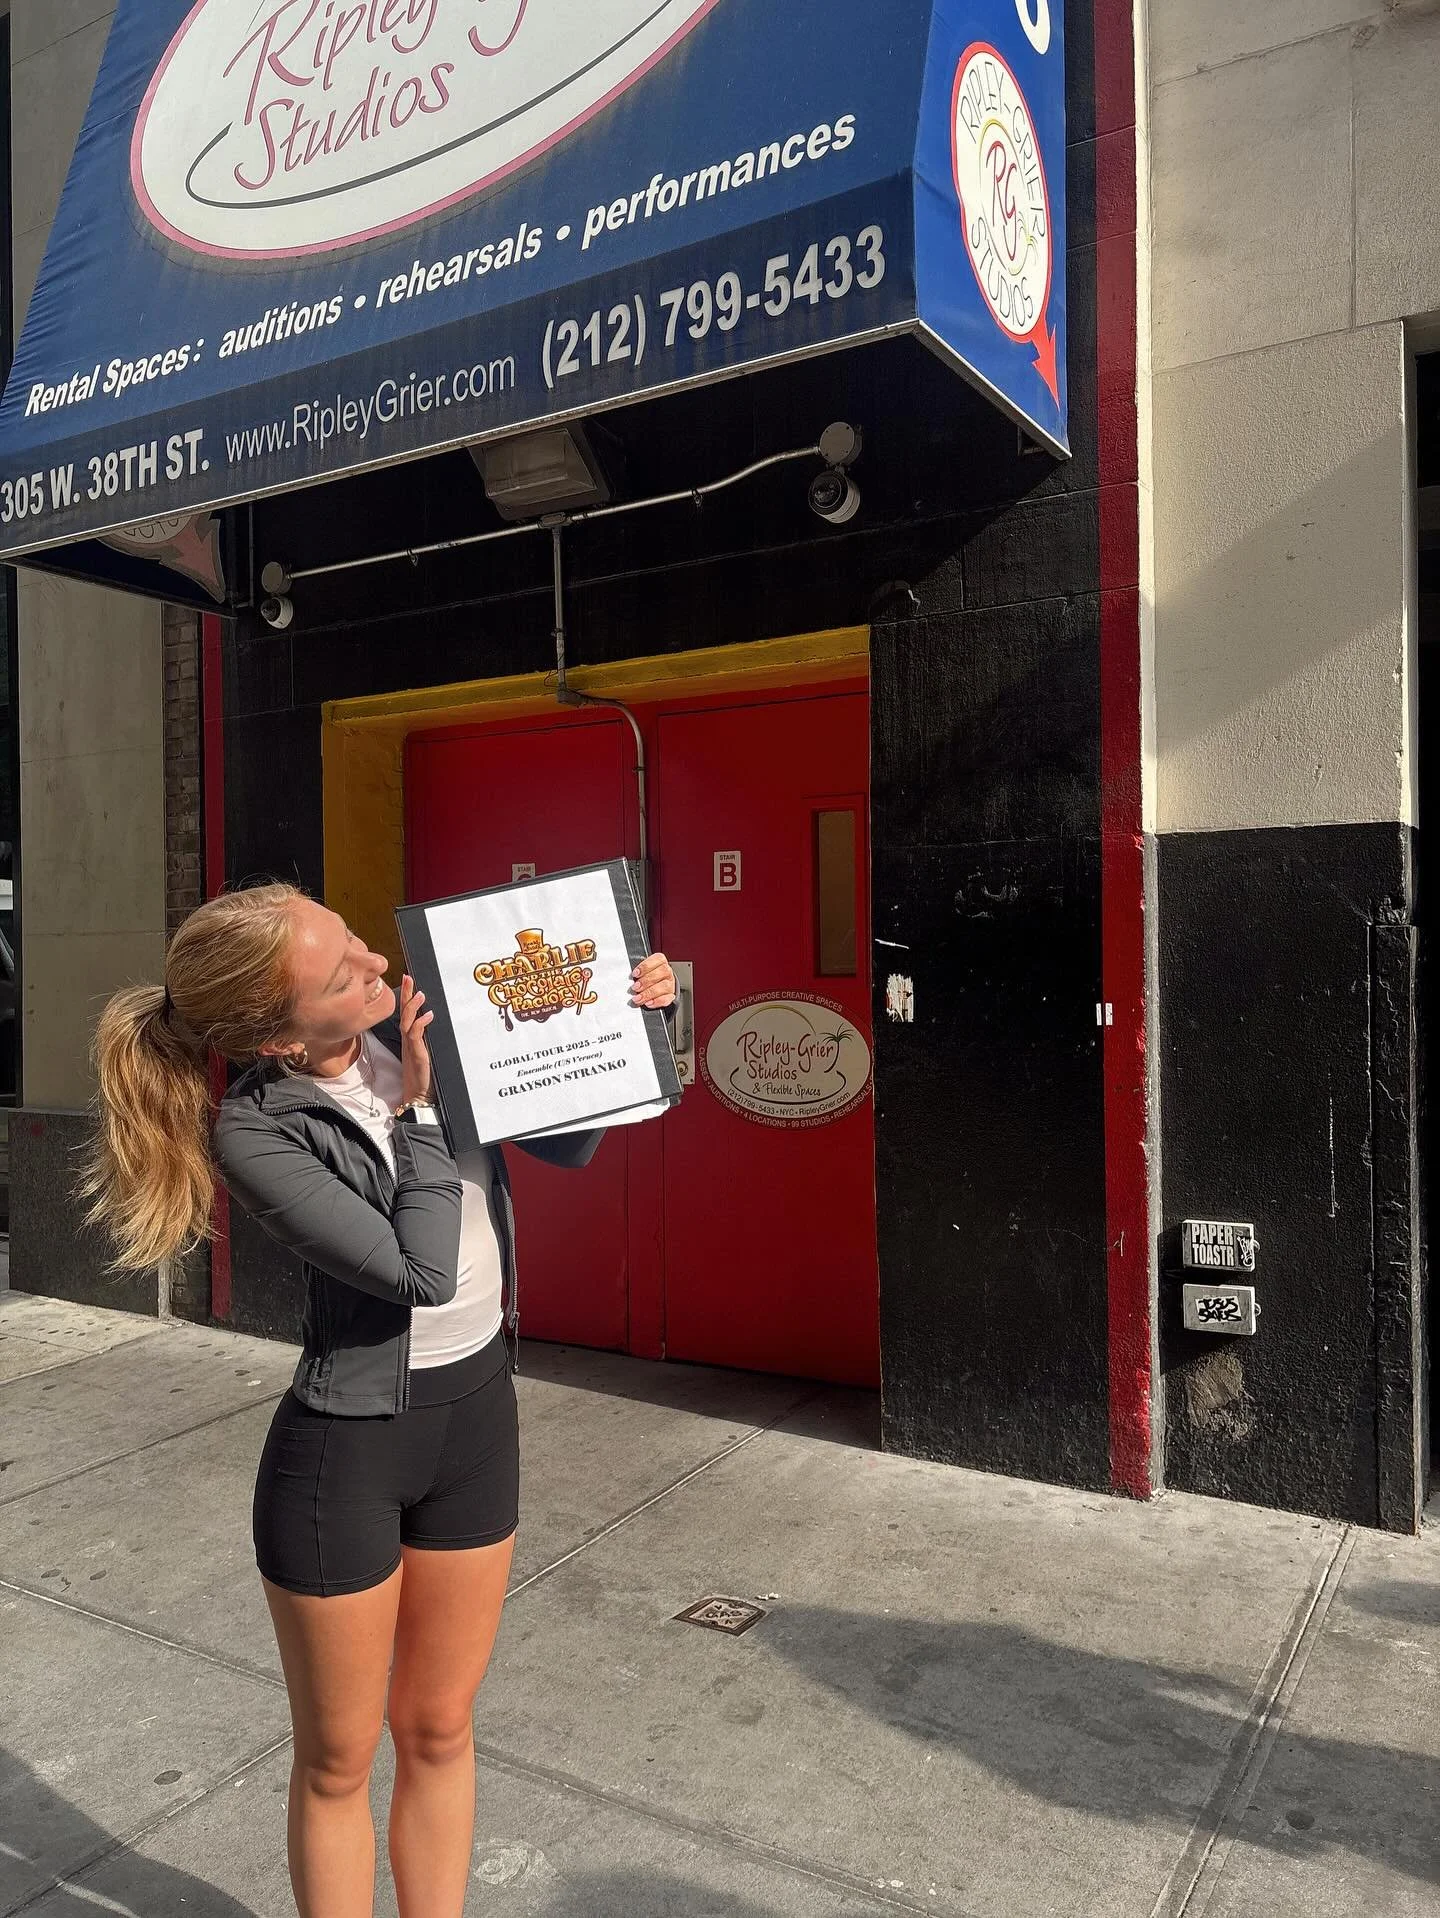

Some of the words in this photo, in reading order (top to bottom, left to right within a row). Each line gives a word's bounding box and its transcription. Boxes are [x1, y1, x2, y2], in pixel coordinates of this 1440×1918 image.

[234, 63, 455, 190] Studios
[960, 61, 1046, 238] RIPLEY-GRIER
[24, 364, 100, 417] Rental
[102, 338, 205, 399] Spaces:
[218, 295, 344, 358] auditions
[376, 222, 543, 309] rehearsals
[581, 113, 857, 251] performances
[970, 216, 1034, 328] STUDIOS
[0, 471, 45, 524] 305
[50, 463, 81, 510] W.
[87, 440, 158, 500] 38TH
[165, 428, 210, 481] ST.
[226, 355, 515, 463] www.RipleyGrier.com
[541, 294, 647, 390] (212)
[659, 224, 887, 347] 799-5433
[719, 862, 737, 888] B
[473, 938, 597, 986] CHARLIE
[515, 974, 538, 984] AND
[541, 967, 563, 979] THE
[781, 991, 815, 1002] CREATIVE
[815, 996, 843, 1013] SPACES
[489, 1053, 534, 1071] GLOBAL
[533, 1045, 565, 1060] TOUR
[565, 1039, 590, 1052] 2025
[597, 1031, 623, 1044] 2026
[517, 1063, 552, 1078] Ensemble
[553, 1057, 571, 1070] (US
[736, 1031, 834, 1073] Ripley-Grier
[746, 1060, 798, 1081] Studios
[498, 1073, 563, 1098] GRAYSON
[563, 1058, 627, 1082] STRANKO
[752, 1082, 761, 1094] &
[762, 1081, 793, 1096] Flexible
[794, 1083, 821, 1100] Spaces
[708, 1083, 741, 1114] AUDITIONS
[748, 1114, 787, 1128] LOCATIONS
[800, 1115, 831, 1128] STUDIOS
[833, 1083, 873, 1119] REHEARSALS
[779, 1108, 795, 1117] NYC
[1191, 1223, 1234, 1246] PAPER
[1191, 1243, 1235, 1267] TOASTR
